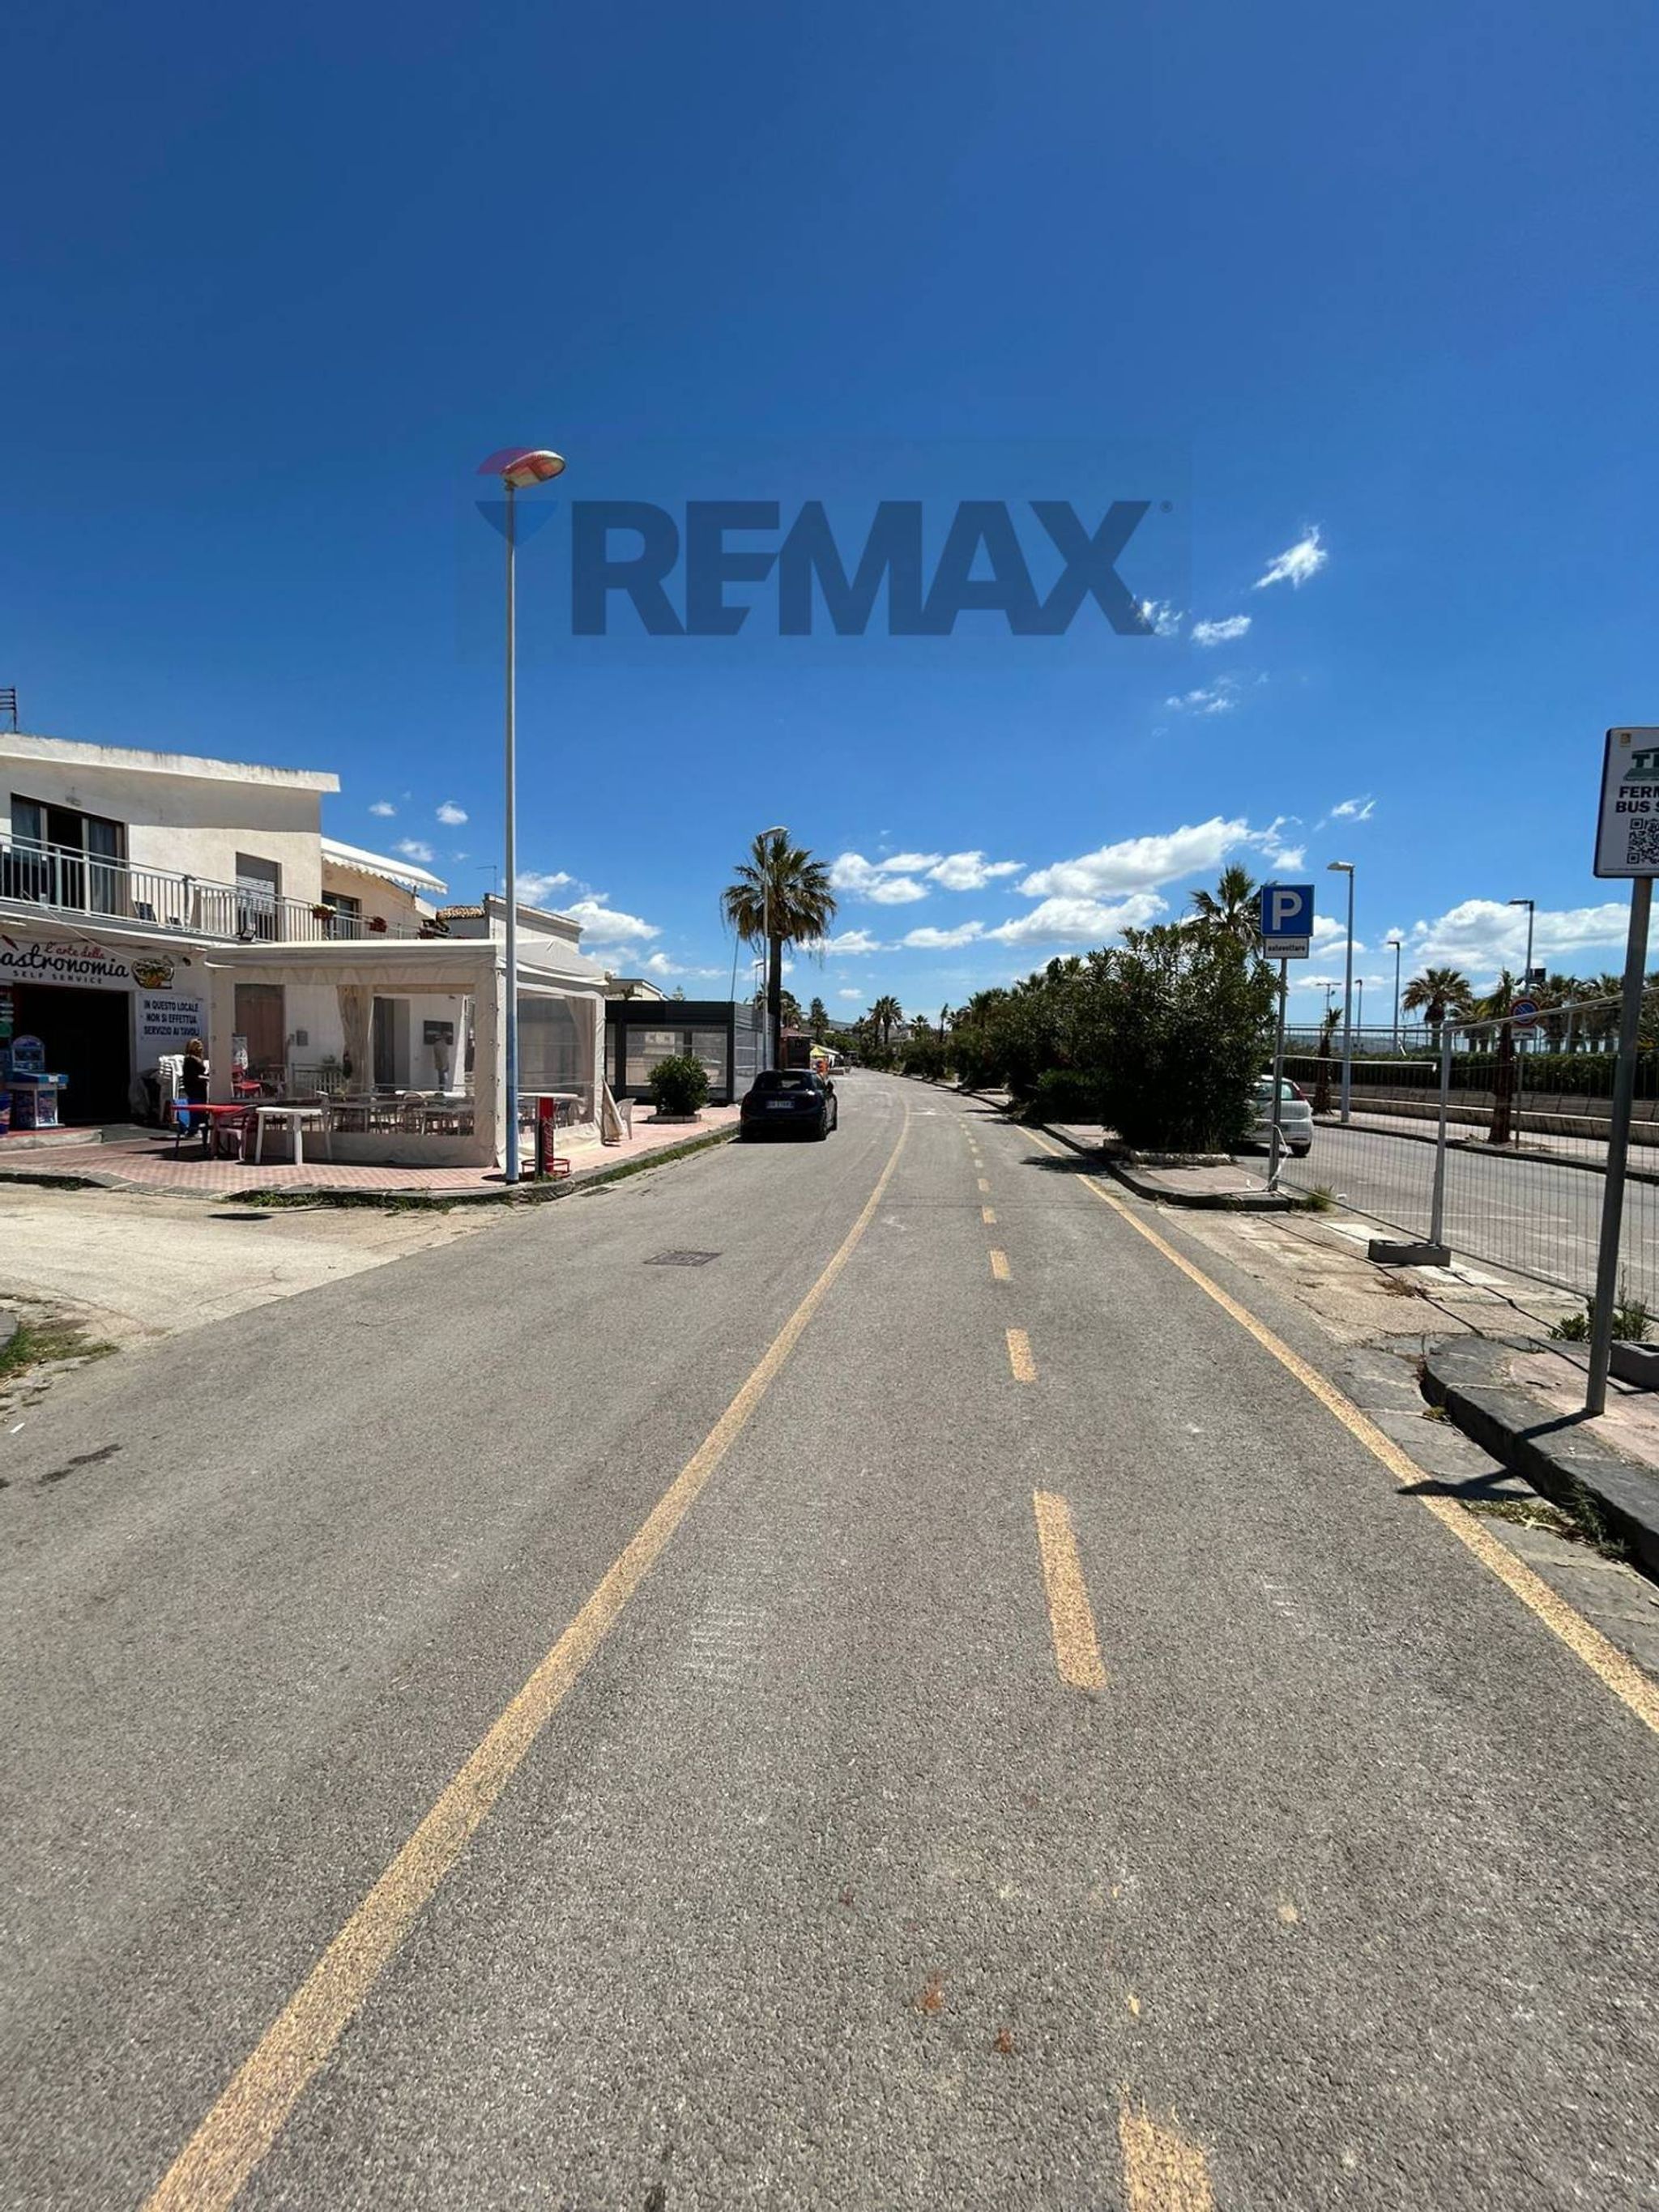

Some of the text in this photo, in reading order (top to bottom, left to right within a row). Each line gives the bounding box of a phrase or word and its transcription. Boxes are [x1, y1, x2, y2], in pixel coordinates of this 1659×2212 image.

[1616, 801, 1650, 813] BUS
[1272, 890, 1303, 931] P
[13, 970, 103, 985] SELF SERVICE
[144, 999, 199, 1012] IN QUESTO LOCALE
[147, 1012, 160, 1022] NON
[168, 1013, 197, 1024] EFFETTUA
